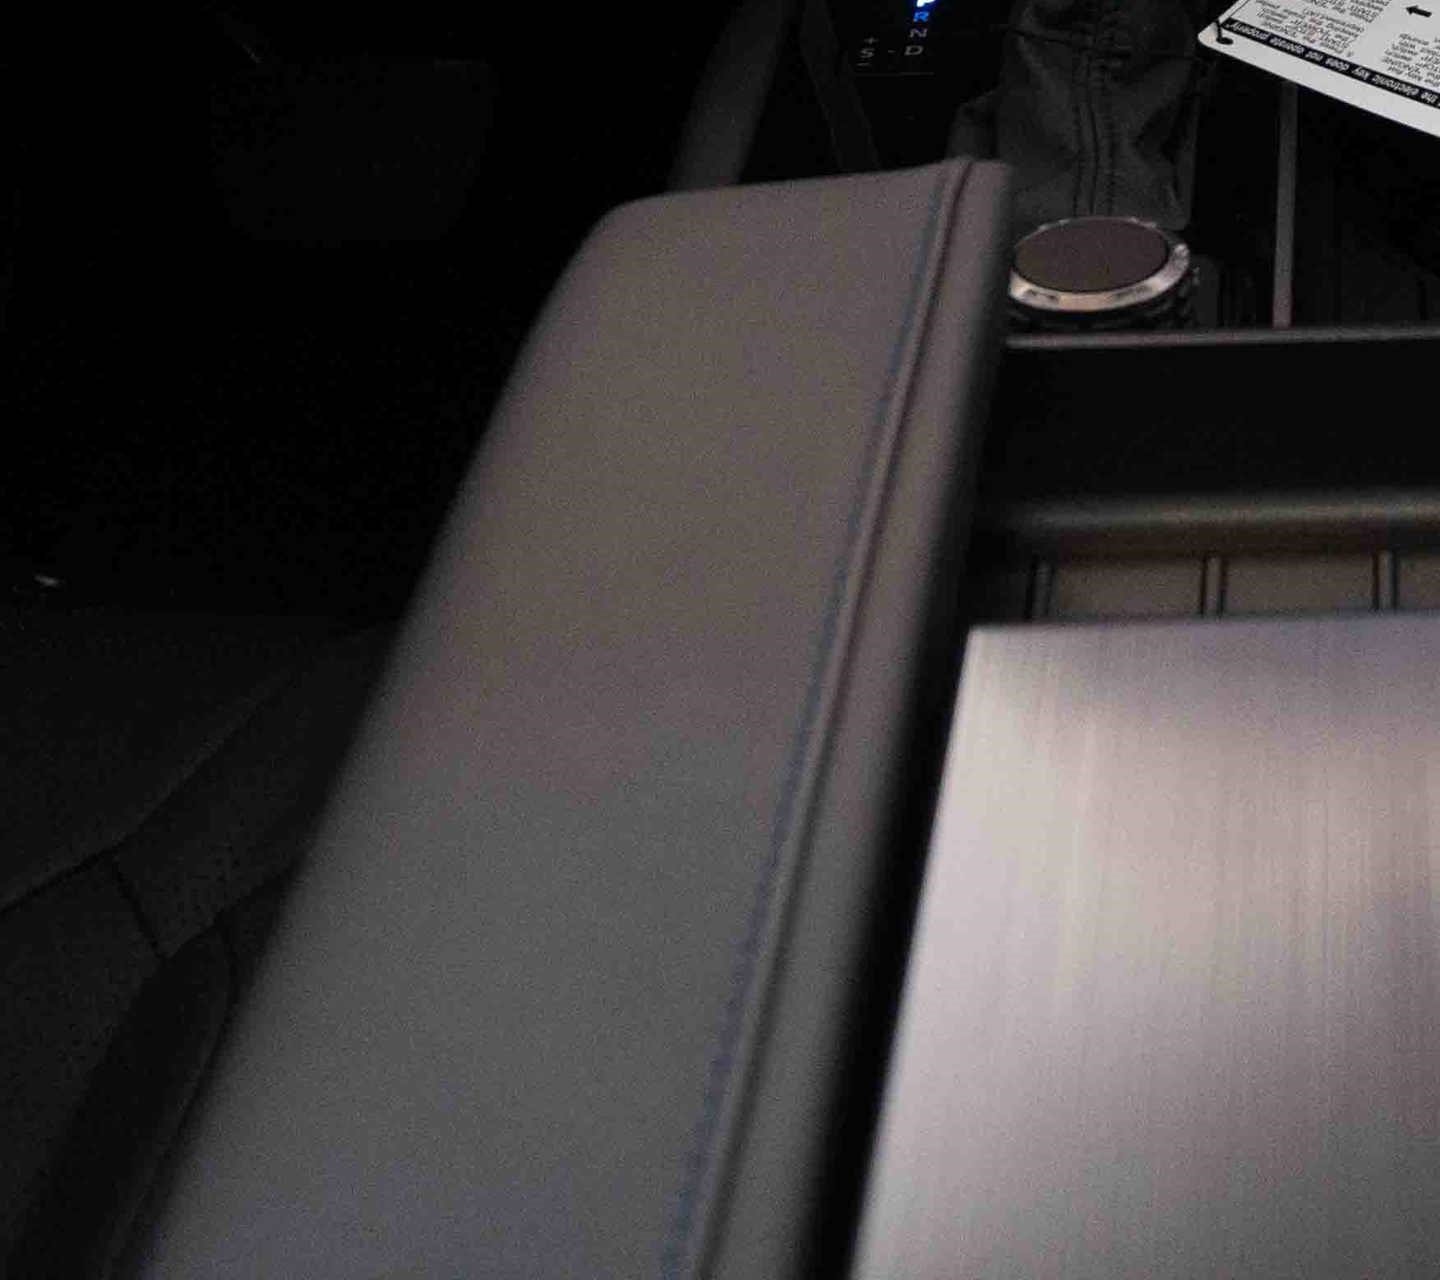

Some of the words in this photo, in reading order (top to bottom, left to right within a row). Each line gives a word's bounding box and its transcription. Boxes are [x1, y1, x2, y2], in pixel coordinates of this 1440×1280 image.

[913, 11, 930, 22] R
[909, 27, 928, 38] N
[904, 45, 924, 56] D
[1266, 34, 1307, 55] operate
[1303, 49, 1325, 62] not
[1322, 56, 1351, 72] does
[1349, 65, 1373, 80] key
[1370, 73, 1420, 97] electronic
[1417, 90, 1439, 104] the
